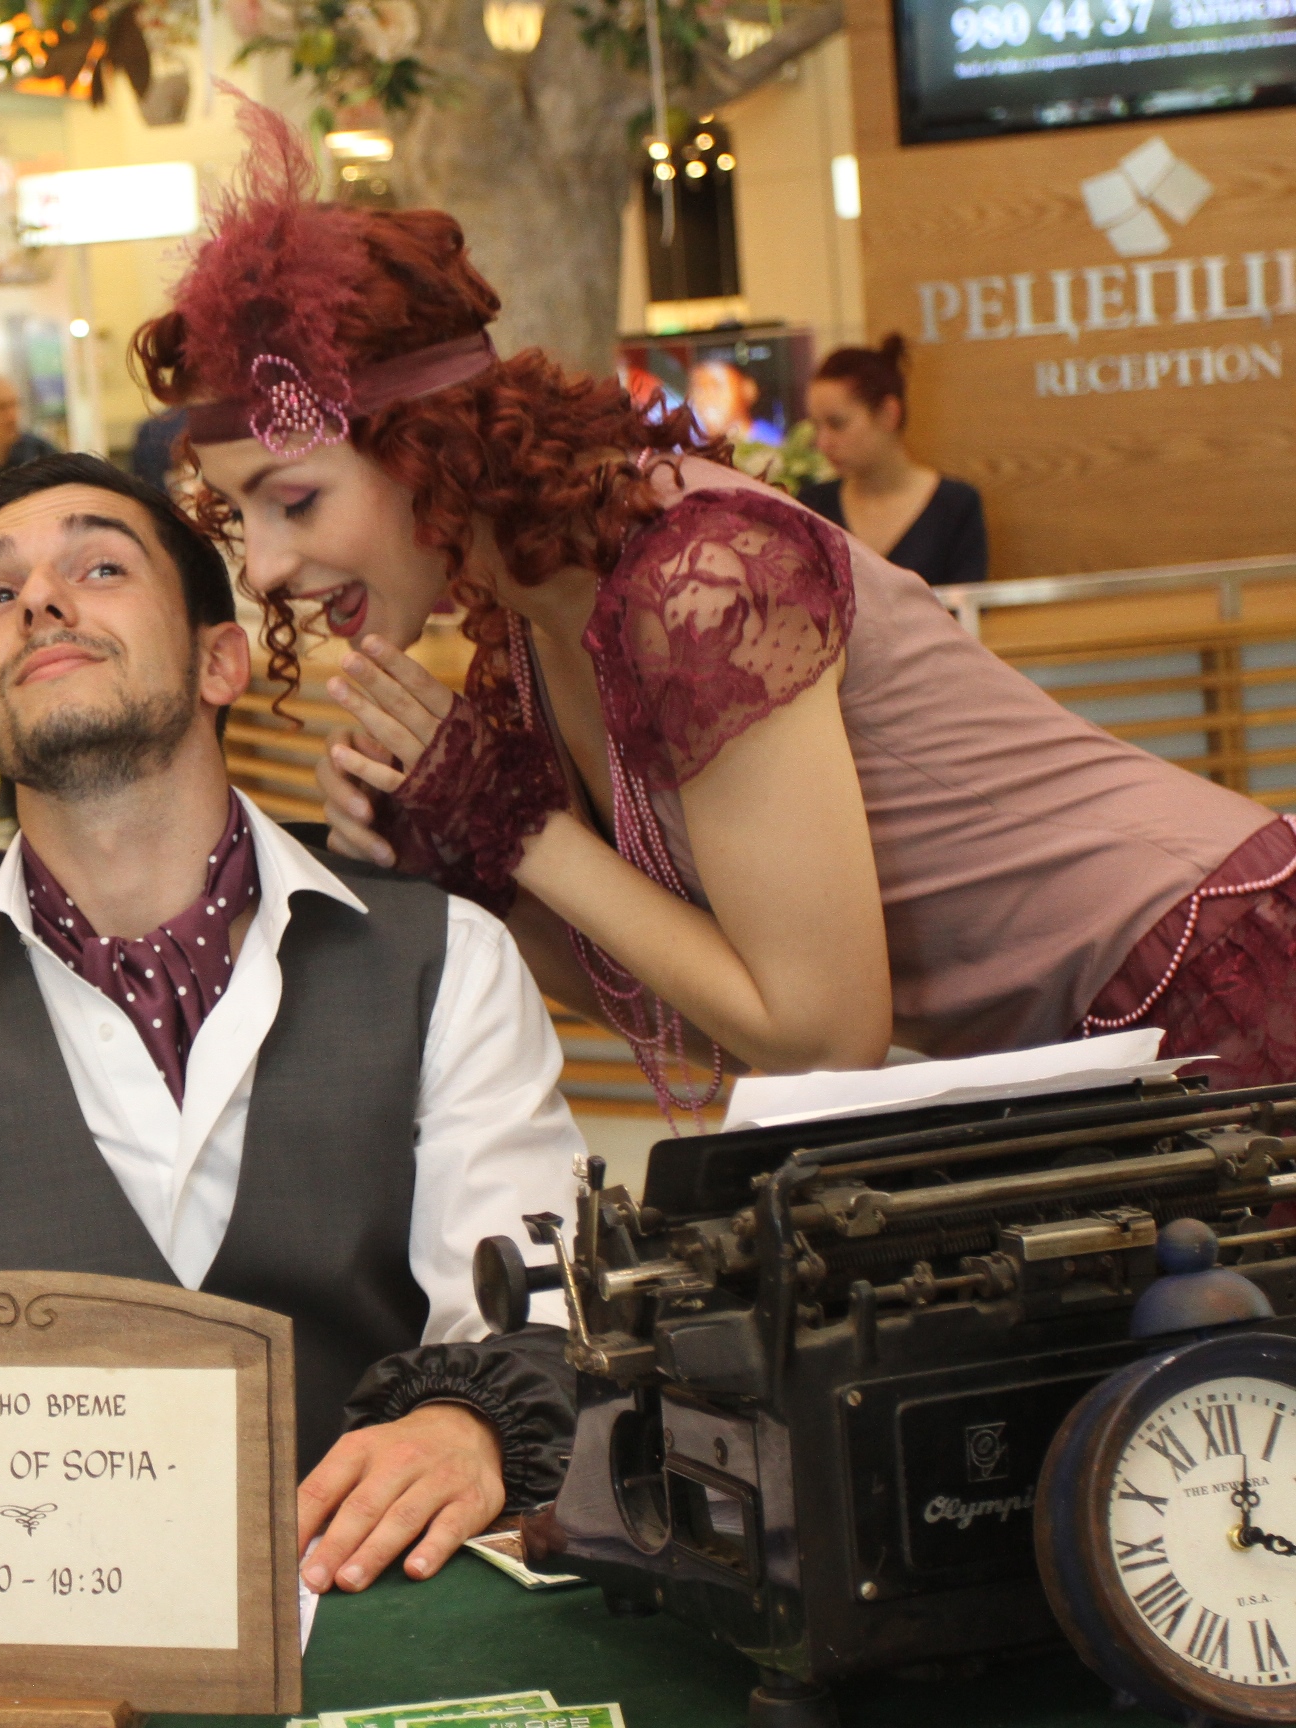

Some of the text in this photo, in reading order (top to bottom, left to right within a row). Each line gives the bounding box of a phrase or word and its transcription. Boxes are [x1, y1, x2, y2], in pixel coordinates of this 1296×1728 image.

[950, 4, 1031, 53] 980
[1037, 0, 1094, 42] 44
[1034, 341, 1283, 398] RECEPTION
[46, 1394, 126, 1418] ВРЕМЕ
[10, 1450, 50, 1480] OF
[62, 1450, 157, 1481] SOFIA
[924, 1484, 1035, 1529] Olympi
[1183, 1486, 1209, 1498] THE
